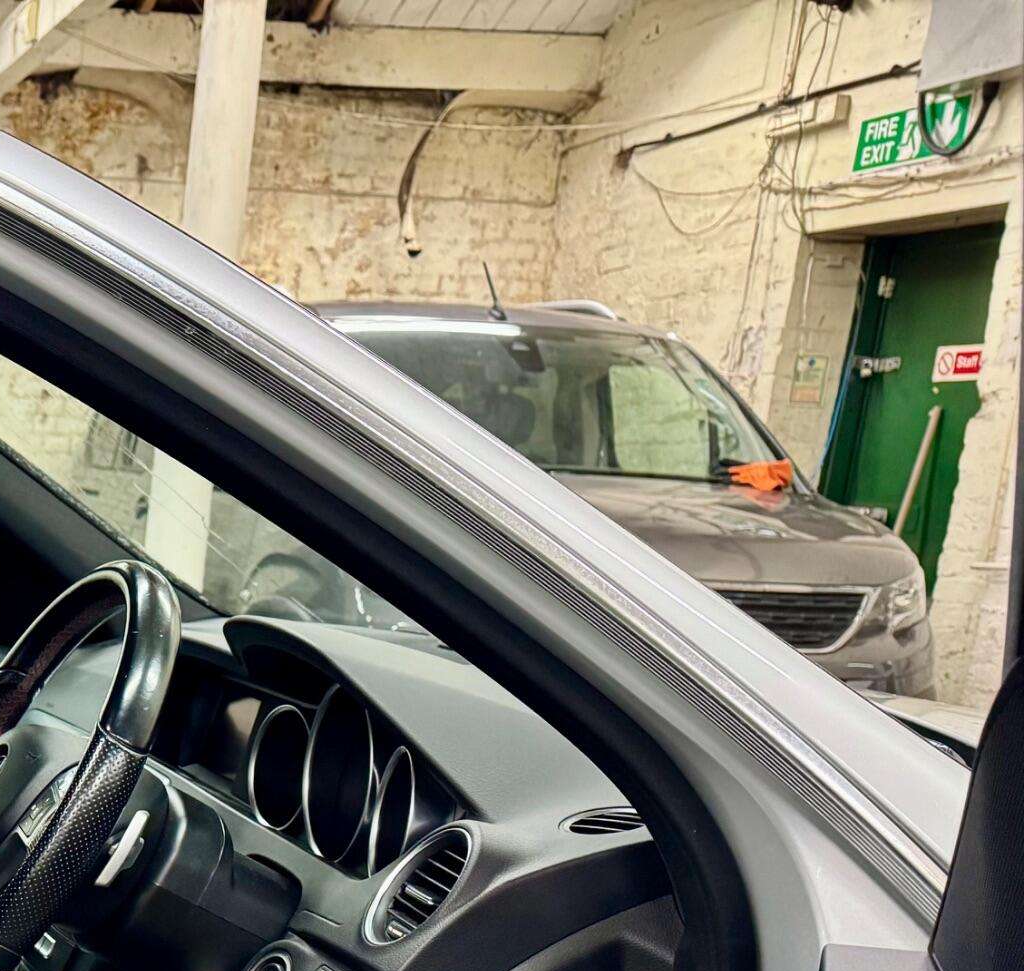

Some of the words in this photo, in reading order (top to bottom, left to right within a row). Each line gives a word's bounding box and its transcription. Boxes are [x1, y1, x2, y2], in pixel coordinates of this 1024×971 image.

[864, 116, 900, 143] FIRE
[860, 140, 896, 167] EXIT
[956, 355, 979, 369] Staff
